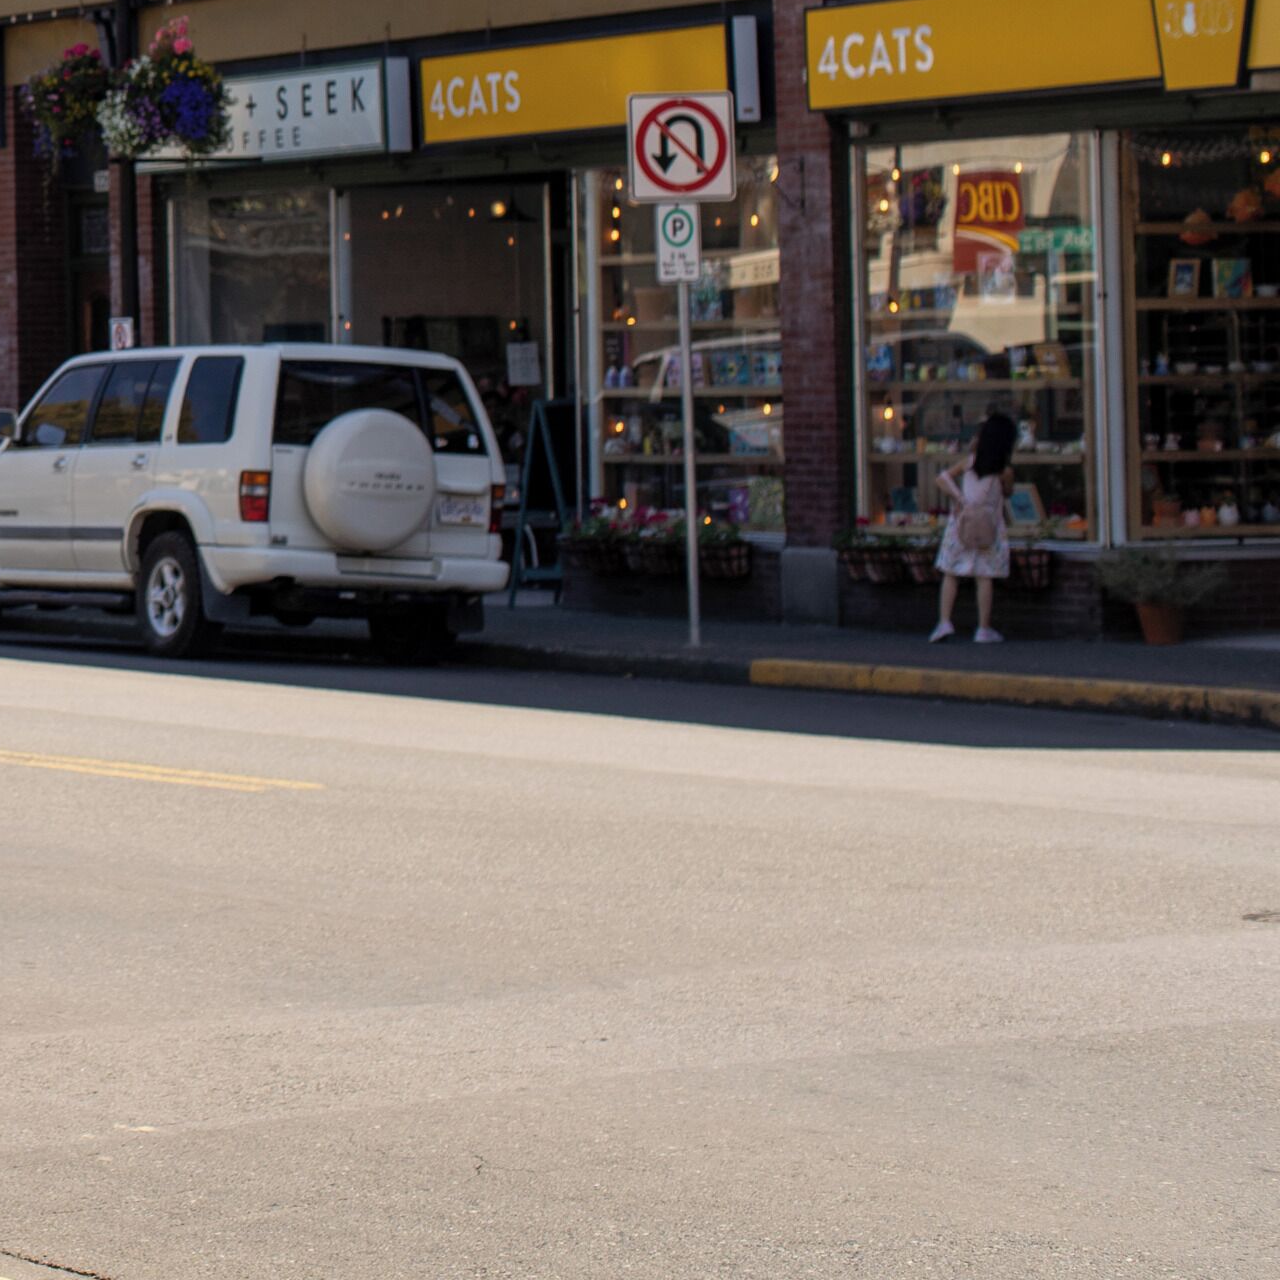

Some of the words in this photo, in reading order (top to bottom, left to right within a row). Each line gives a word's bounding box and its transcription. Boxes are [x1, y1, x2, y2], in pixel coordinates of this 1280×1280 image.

[818, 24, 934, 81] 4CATS
[276, 76, 365, 121] SEEK
[429, 69, 521, 121] 4CATS
